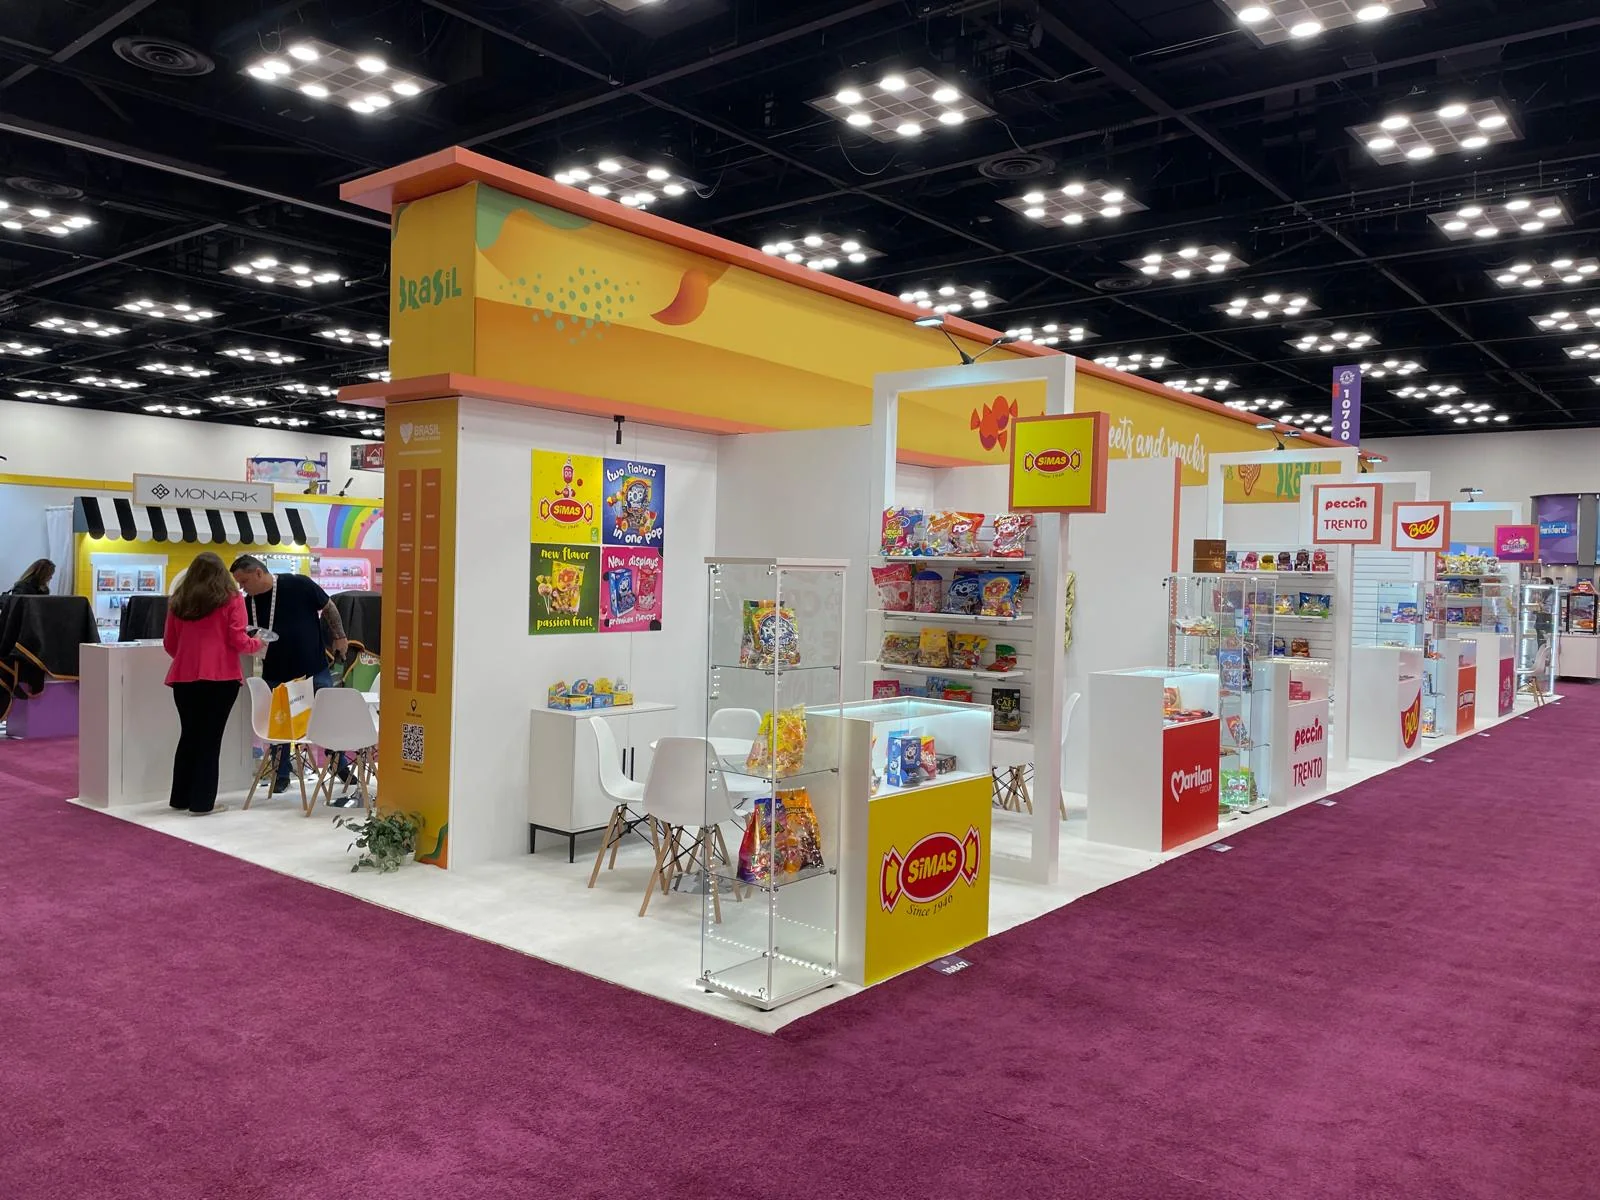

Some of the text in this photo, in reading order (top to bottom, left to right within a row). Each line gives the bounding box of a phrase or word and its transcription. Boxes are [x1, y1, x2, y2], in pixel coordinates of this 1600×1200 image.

[1341, 388, 1351, 440] 10700
[414, 424, 440, 437] BRASIL
[1136, 427, 1165, 458] and
[606, 462, 657, 482] two flavors
[174, 488, 258, 503] MONARK
[1325, 497, 1367, 511] peccin
[612, 525, 623, 540] in
[625, 534, 643, 544] one
[644, 527, 663, 544] pop
[1323, 519, 1368, 532] TRENTO
[1408, 518, 1436, 538] Bel
[541, 546, 590, 561] new flavor
[607, 555, 659, 569] New displays
[536, 616, 593, 630] passion fruit
[1294, 717, 1322, 752] peccin
[1293, 757, 1323, 787] TRENTO
[1171, 764, 1212, 803] Marilan
[906, 893, 954, 917] Since 1946
